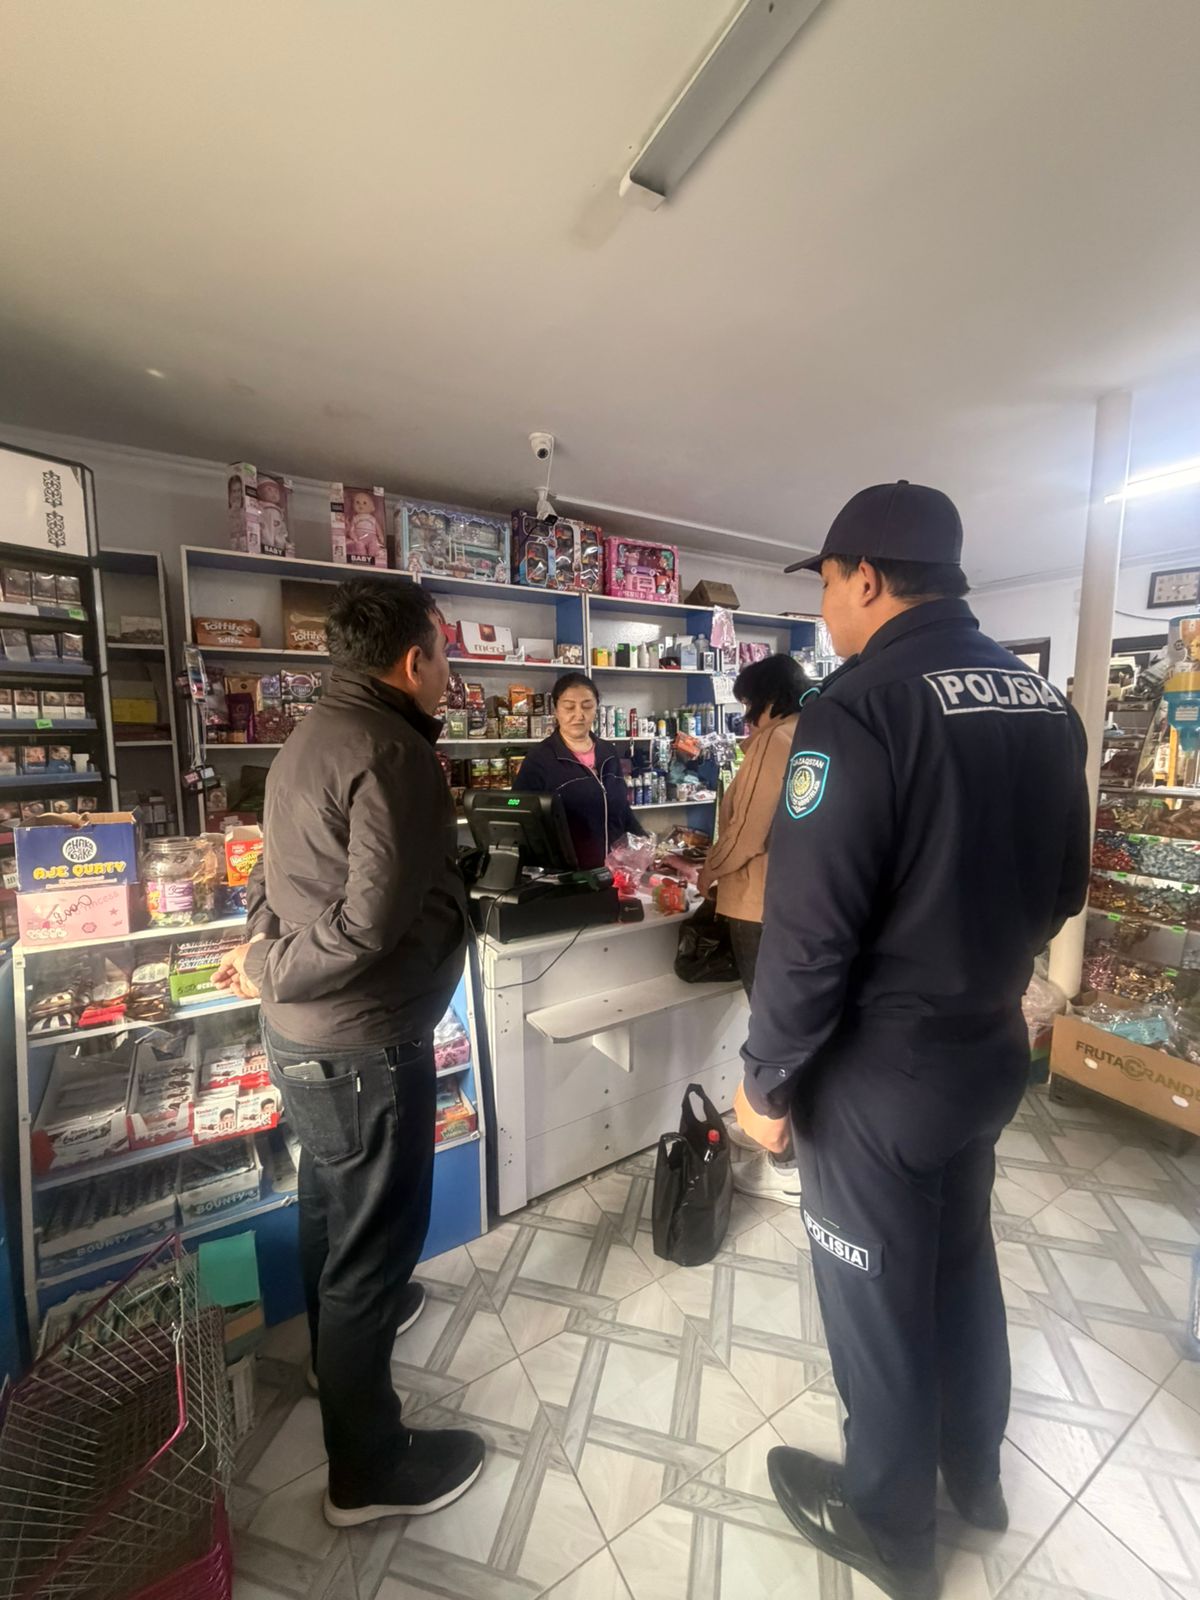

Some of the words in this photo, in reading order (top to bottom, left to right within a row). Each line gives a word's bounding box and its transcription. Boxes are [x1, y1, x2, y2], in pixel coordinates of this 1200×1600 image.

[264, 545, 283, 556] BABY
[351, 555, 373, 563] BABY
[200, 620, 253, 634] Toffifee
[474, 645, 505, 653] merci
[937, 673, 1063, 708] POLISIA
[196, 1191, 246, 1214] BOUNTY
[77, 1233, 130, 1257] BOUNTY
[804, 1215, 864, 1267] POLISIA
